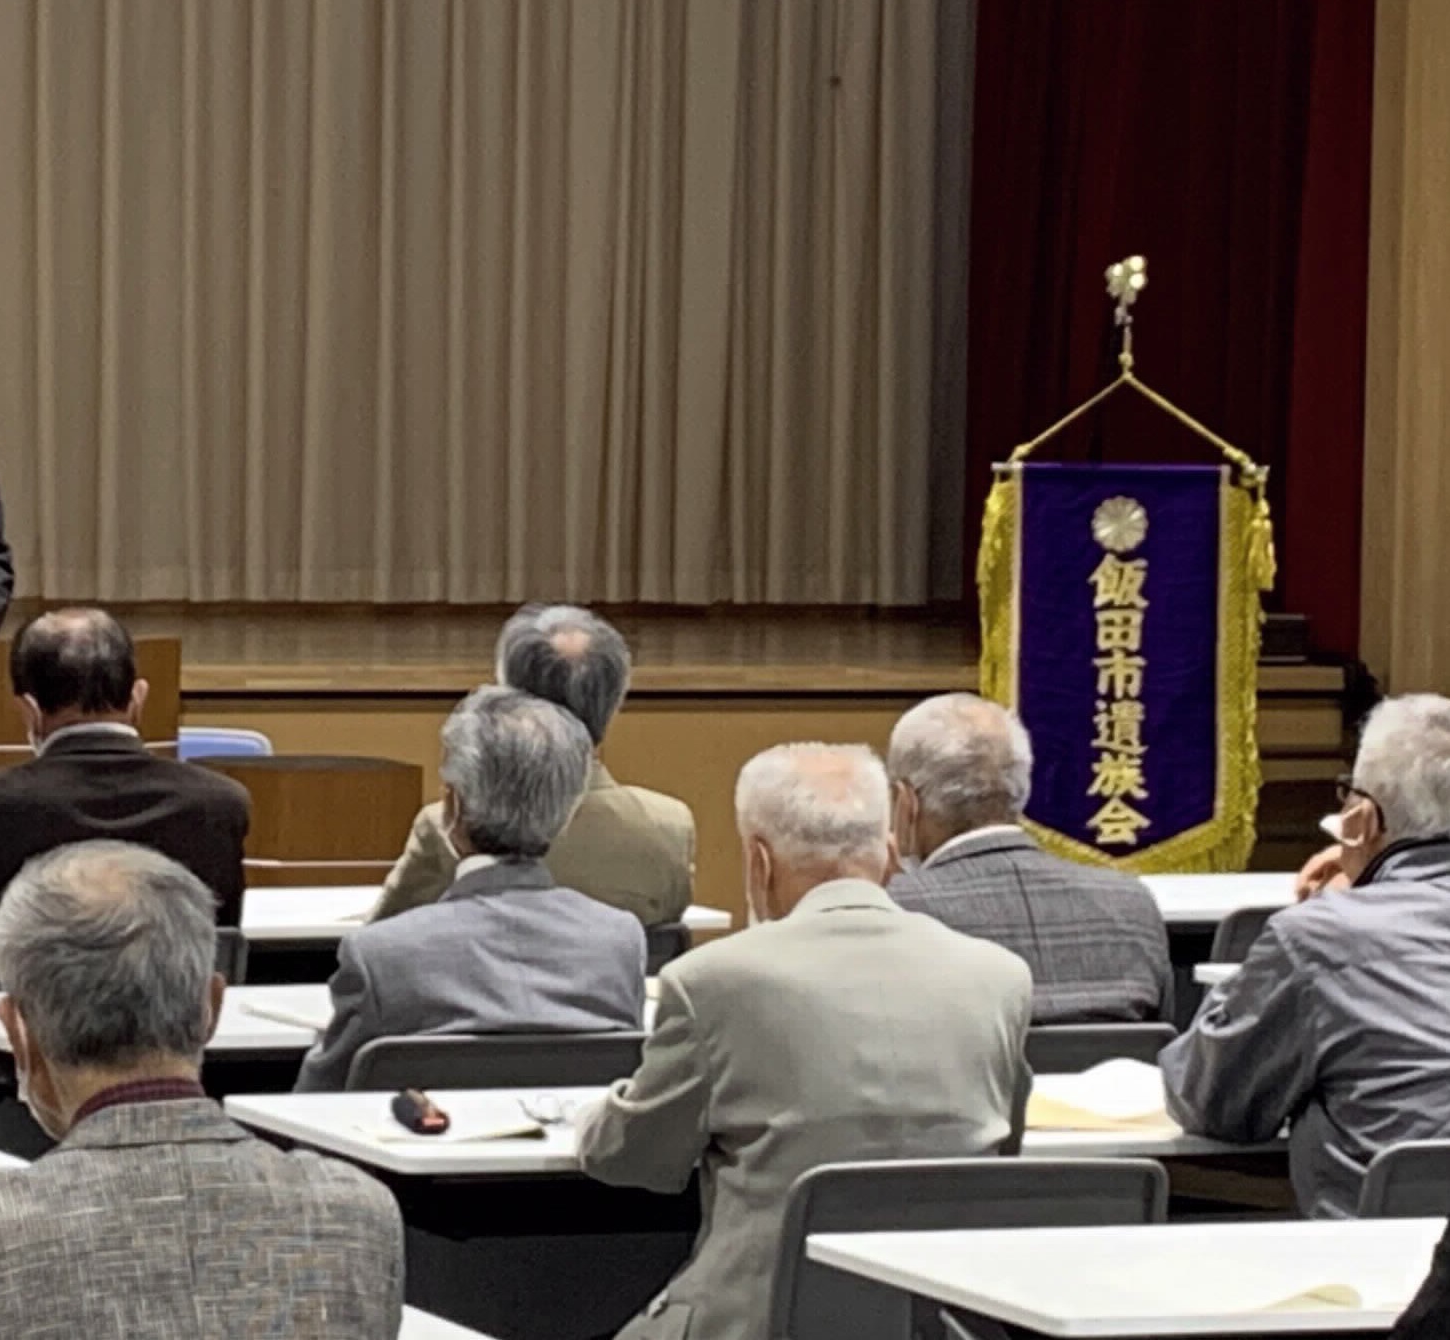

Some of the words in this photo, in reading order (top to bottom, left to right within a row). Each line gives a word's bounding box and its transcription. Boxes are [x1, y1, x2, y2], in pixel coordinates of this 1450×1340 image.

[1087, 554, 1150, 845] 飯田市遺族会
